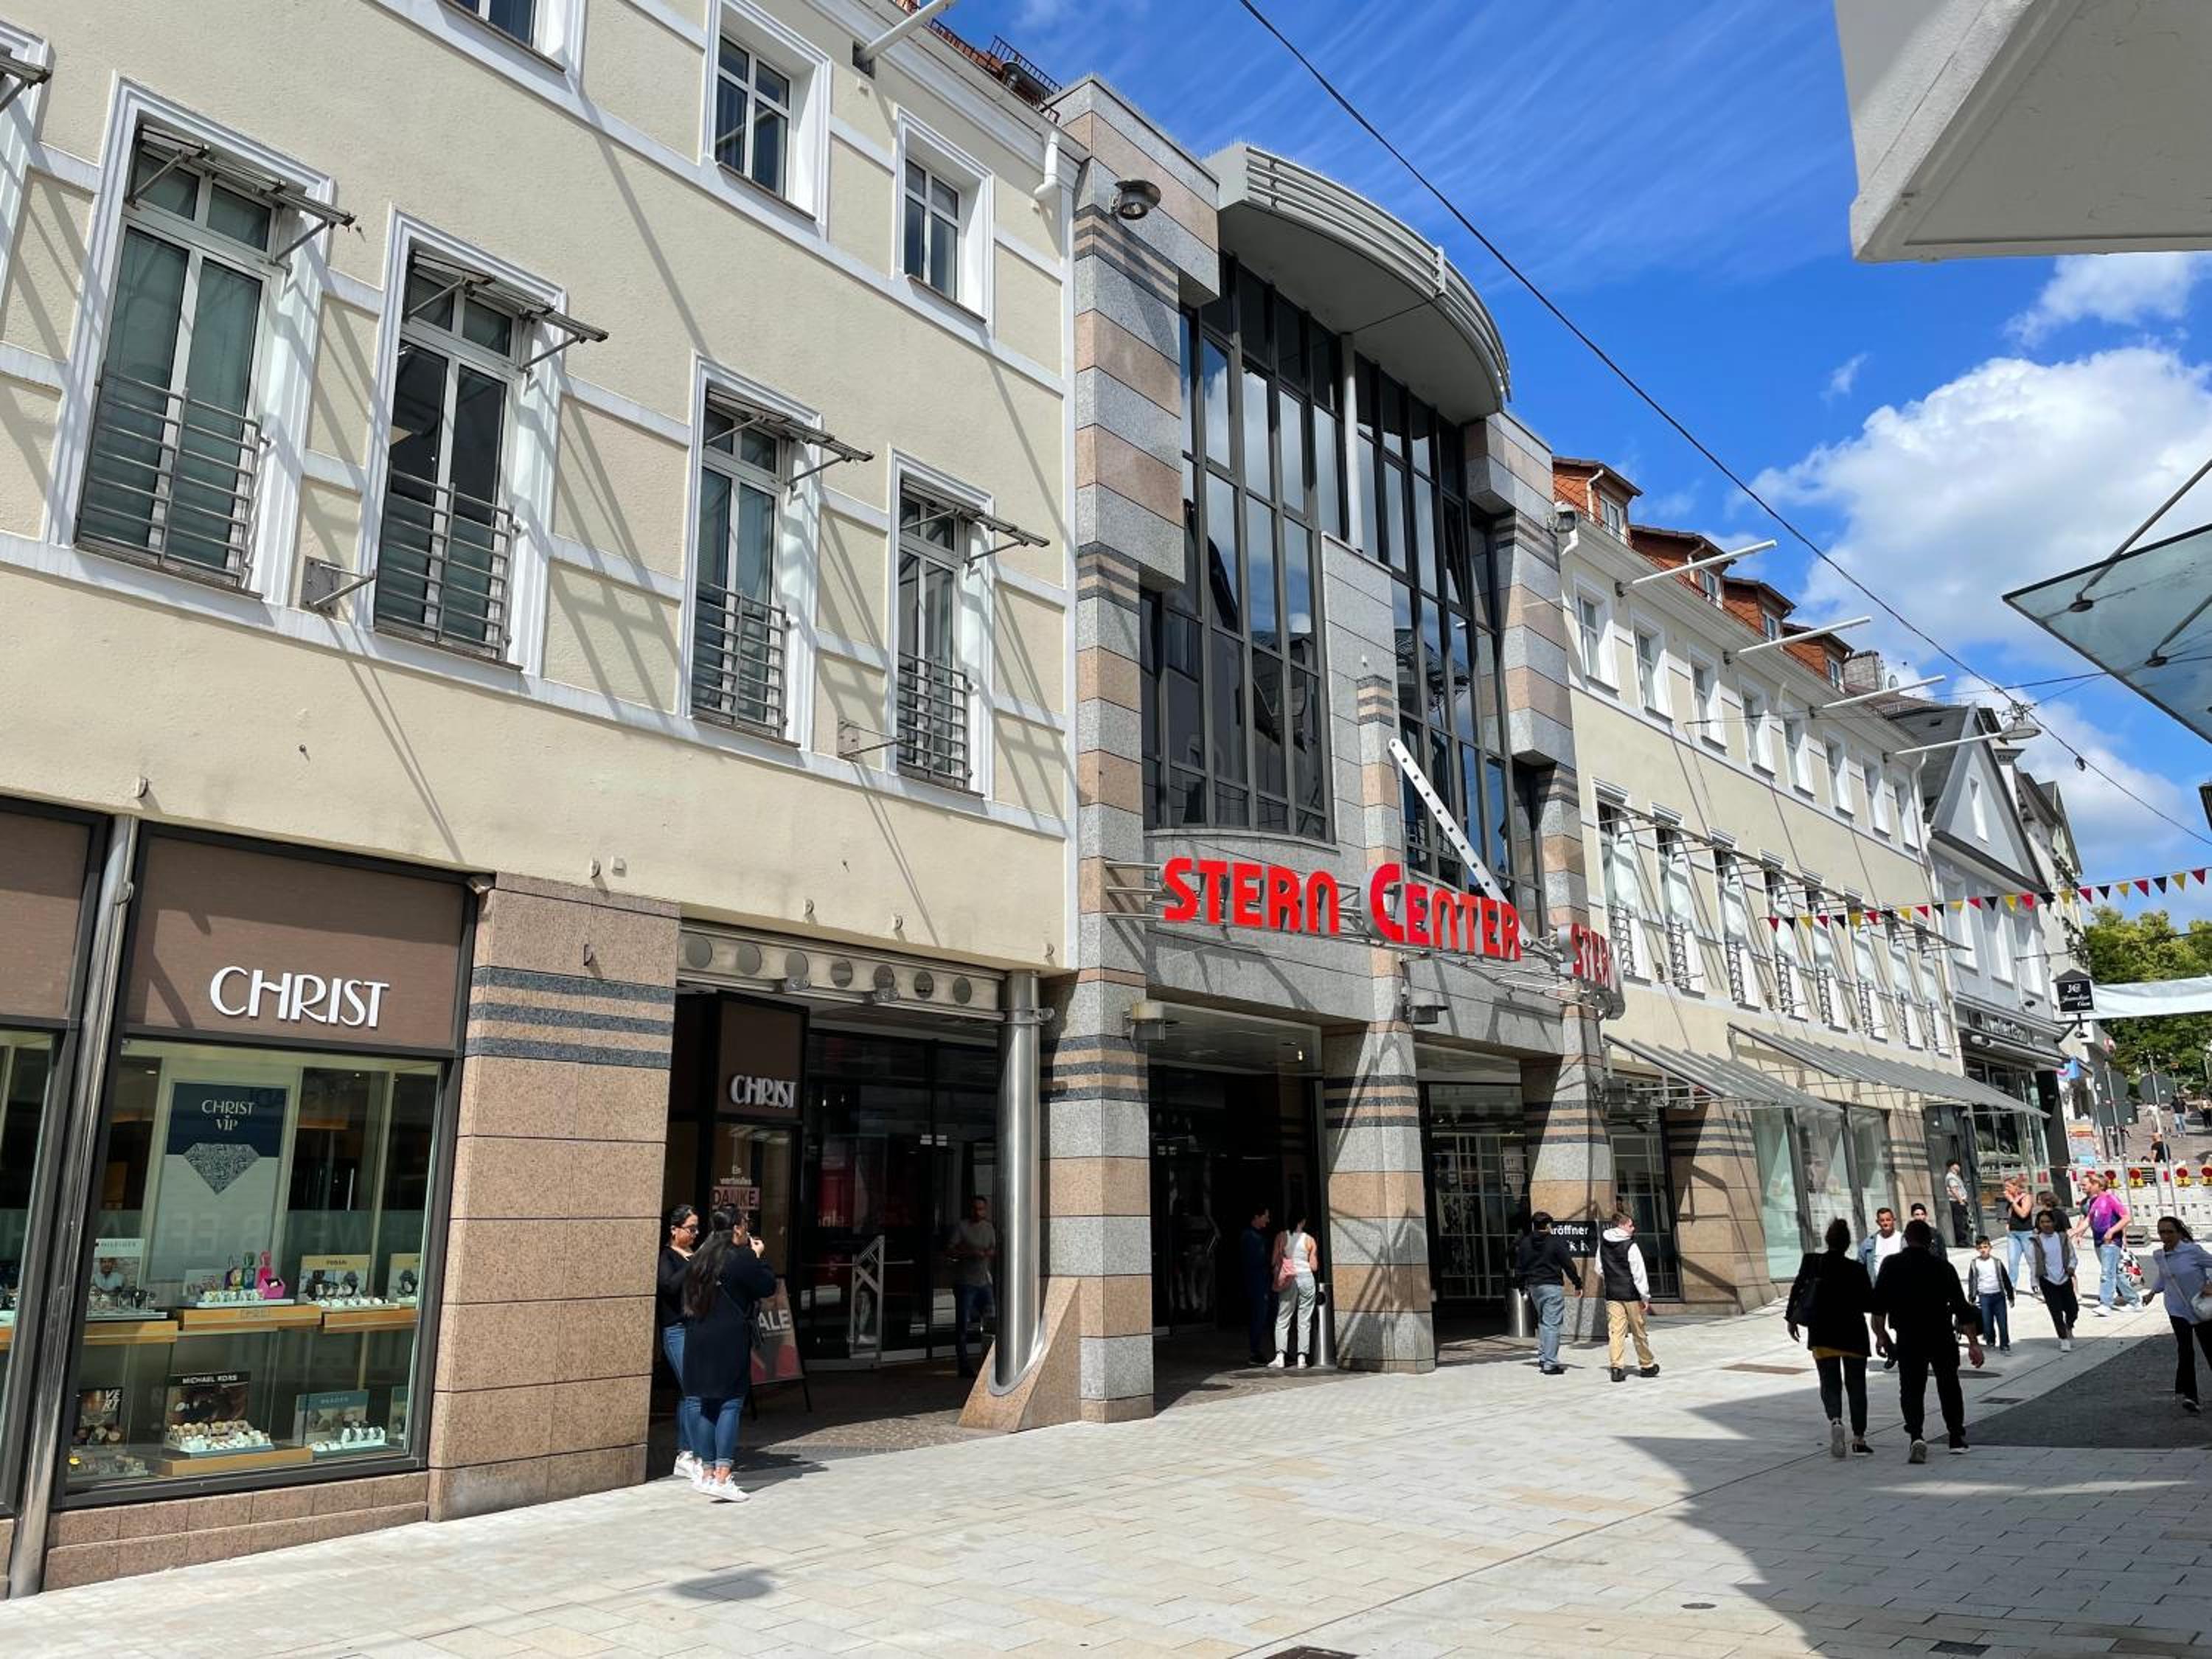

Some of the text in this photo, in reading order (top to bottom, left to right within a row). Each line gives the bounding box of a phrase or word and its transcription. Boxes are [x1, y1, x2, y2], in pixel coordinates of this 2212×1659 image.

[1162, 858, 1521, 961] STERN CENTER
[209, 965, 390, 1028] CHRIST
[201, 1099, 255, 1116] CHRIST
[730, 1074, 797, 1108] CHRIST
[757, 1309, 791, 1331] ALE
